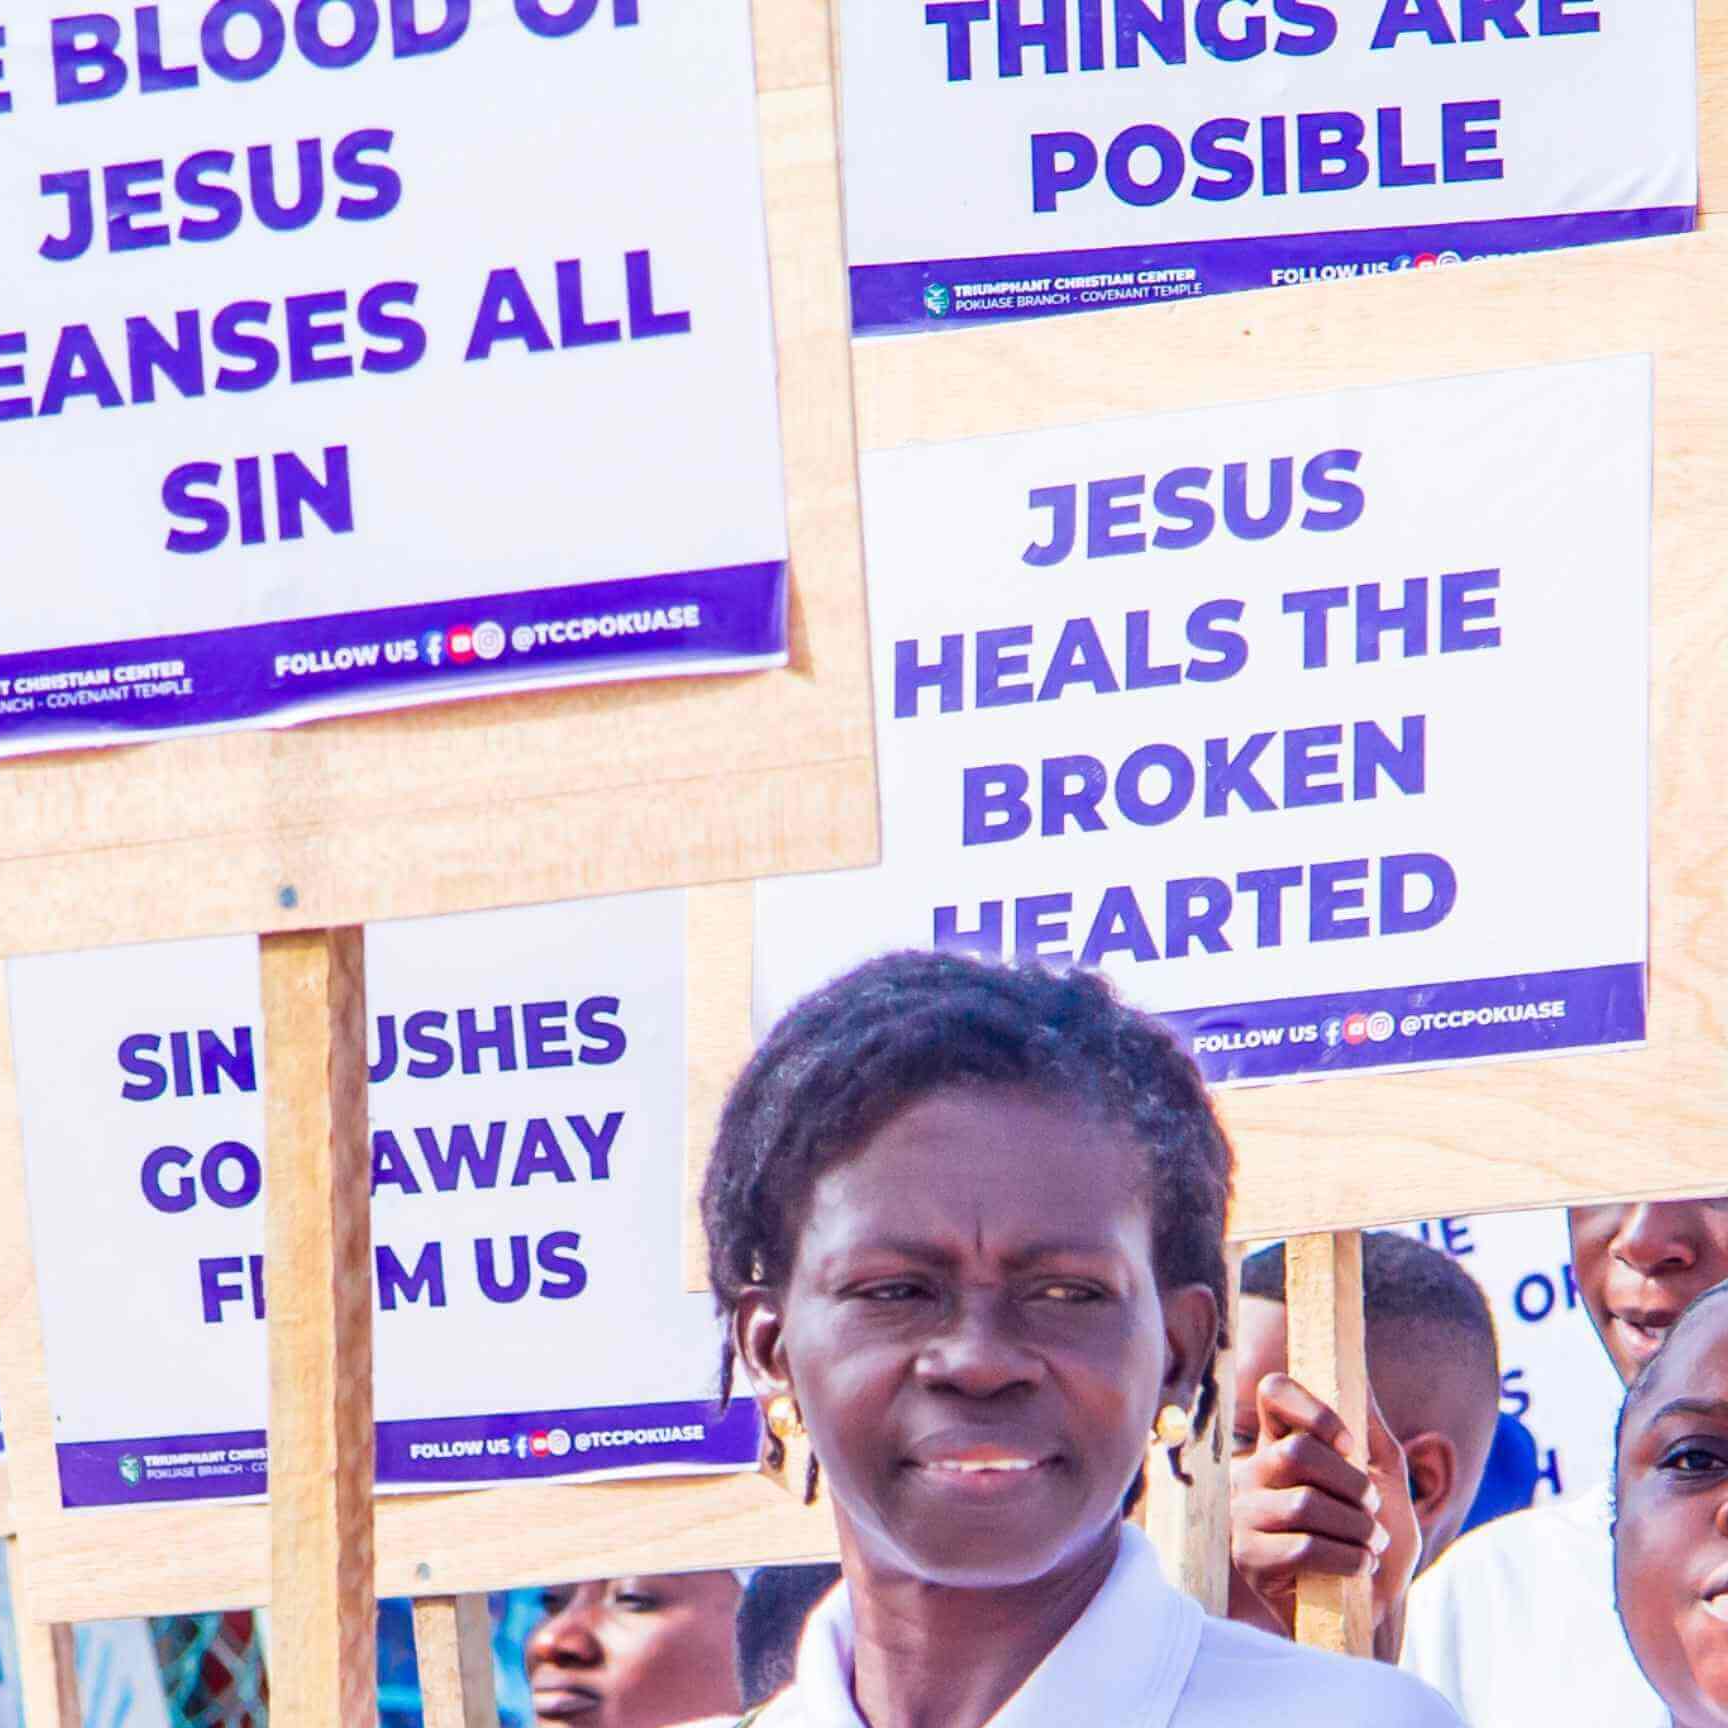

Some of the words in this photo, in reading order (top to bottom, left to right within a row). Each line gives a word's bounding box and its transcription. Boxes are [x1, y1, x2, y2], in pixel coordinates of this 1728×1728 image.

[51, 0, 470, 105] BLOOD
[924, 0, 1338, 82] THINGS
[40, 129, 400, 260] JESUS
[1031, 99, 1503, 212] POSIBLE
[466, 250, 690, 360] ALL
[954, 280, 1052, 298] TRIUMPHANT
[1054, 273, 1136, 292] CHRISTIAN
[1137, 268, 1197, 285] CENTER
[955, 294, 1015, 312] POKUASE
[1016, 291, 1071, 309] BRANCH
[1080, 286, 1152, 304] COVENANT
[1153, 281, 1203, 299] TEMPLE
[1271, 264, 1353, 286] FOLLOW
[162, 445, 353, 553] SIN
[1024, 450, 1363, 565] JESUS
[13, 668, 112, 695] CHRISTIAN
[112, 659, 185, 684] CENTER
[274, 643, 379, 677] FOLLOW
[384, 638, 419, 665] US
[511, 605, 700, 653] @TCCPOKUASE
[896, 600, 1247, 717] HEALS
[1283, 570, 1500, 667] THE
[45, 685, 133, 709] COVENANT
[133, 678, 194, 698] TEMPLE
[964, 716, 1424, 845] BROKEN
[934, 852, 1458, 967] HEARTED
[119, 1027, 256, 1100] SIN
[367, 995, 627, 1083] USHES
[1192, 1028, 1284, 1054] FOLLOW
[1288, 1024, 1318, 1044] US
[1400, 1000, 1567, 1037] @TCCPOKUASE
[140, 1140, 262, 1213] GO
[370, 1110, 626, 1198] AWAY
[198, 1240, 447, 1323] FM
[475, 1232, 586, 1302] US
[409, 1439, 485, 1460] FOLLOW
[487, 1437, 511, 1455] US
[574, 1424, 705, 1452] @TCCPOKUASE
